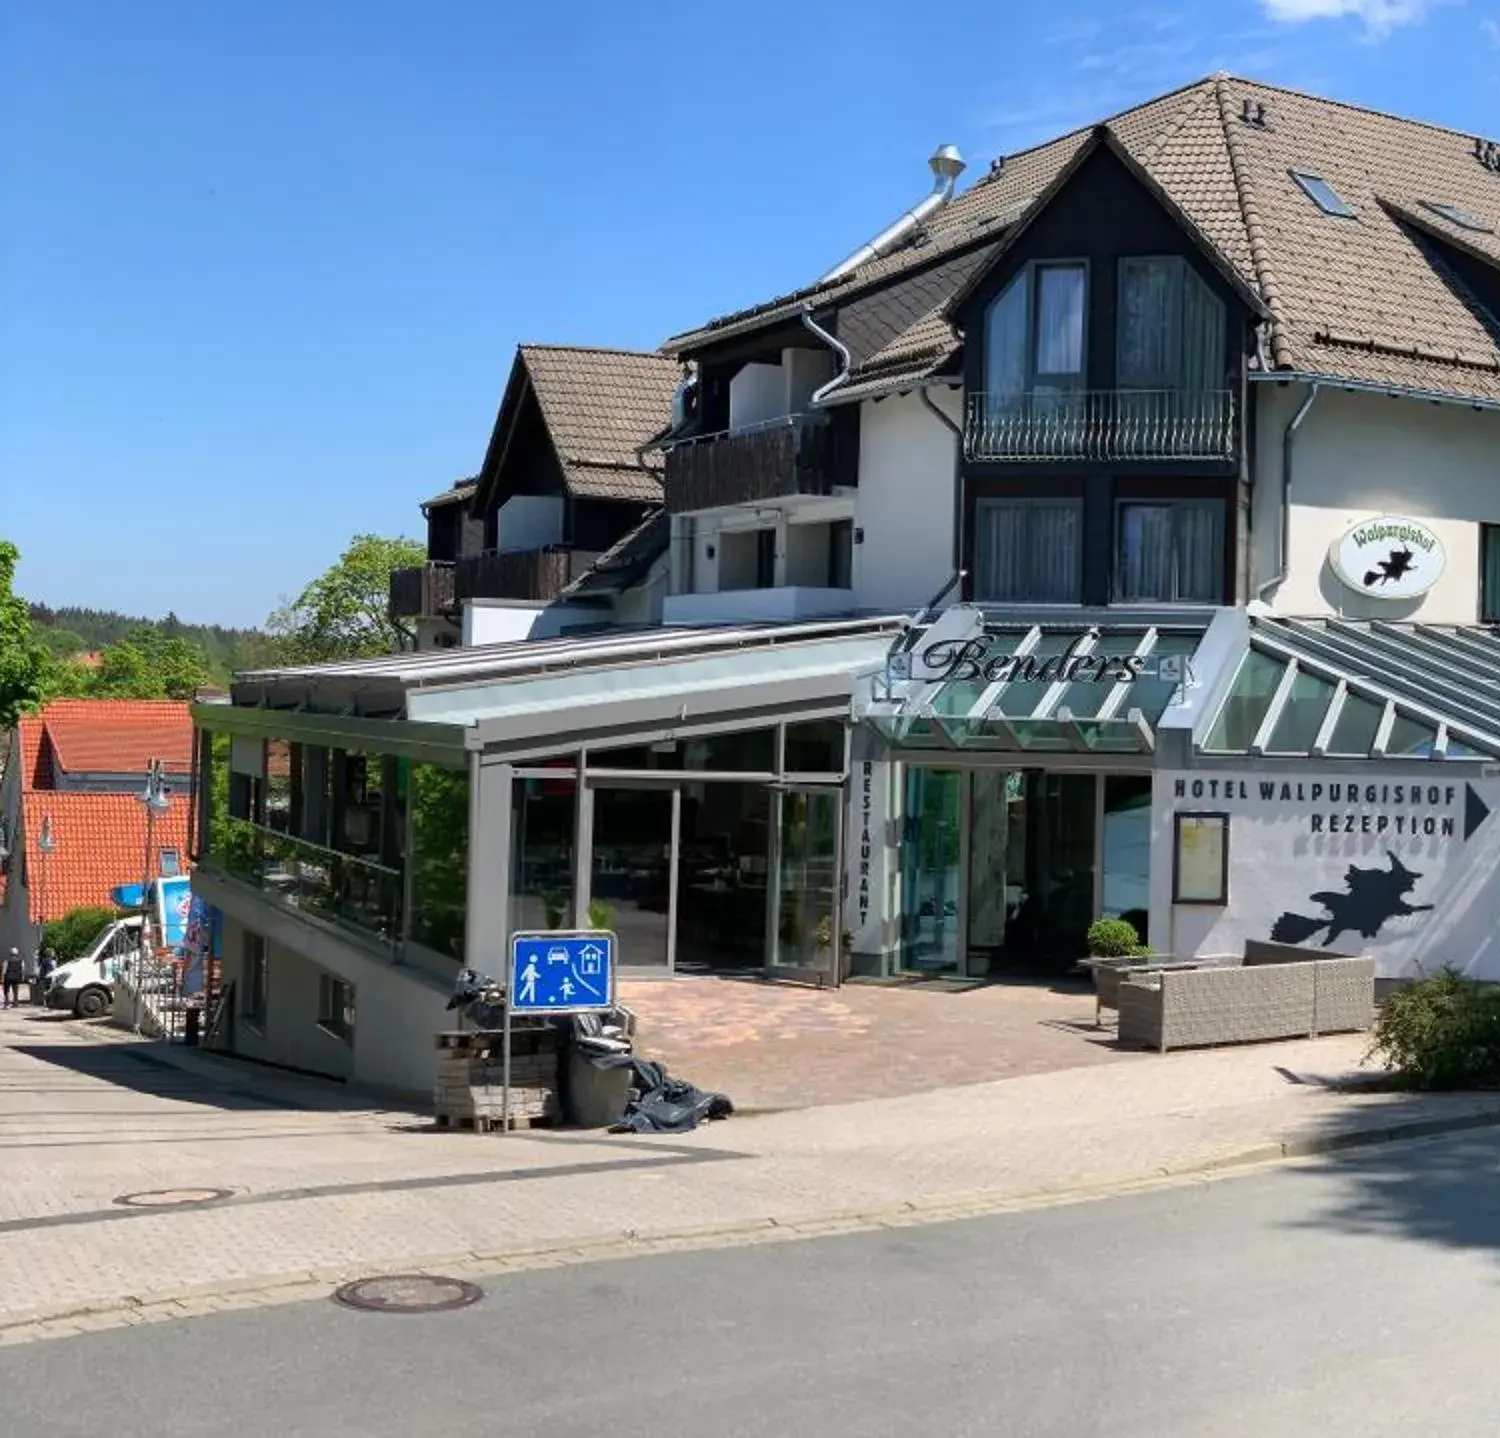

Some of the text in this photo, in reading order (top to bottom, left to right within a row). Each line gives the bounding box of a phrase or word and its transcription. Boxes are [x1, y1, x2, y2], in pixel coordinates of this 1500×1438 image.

[1352, 523, 1437, 553] Walpurgishof
[922, 632, 1144, 684] Benders
[1174, 779, 1456, 805] HOTEL WALPURGISHOF
[1311, 813, 1454, 836] REZEPTION
[859, 761, 872, 926] RESTAURANT
